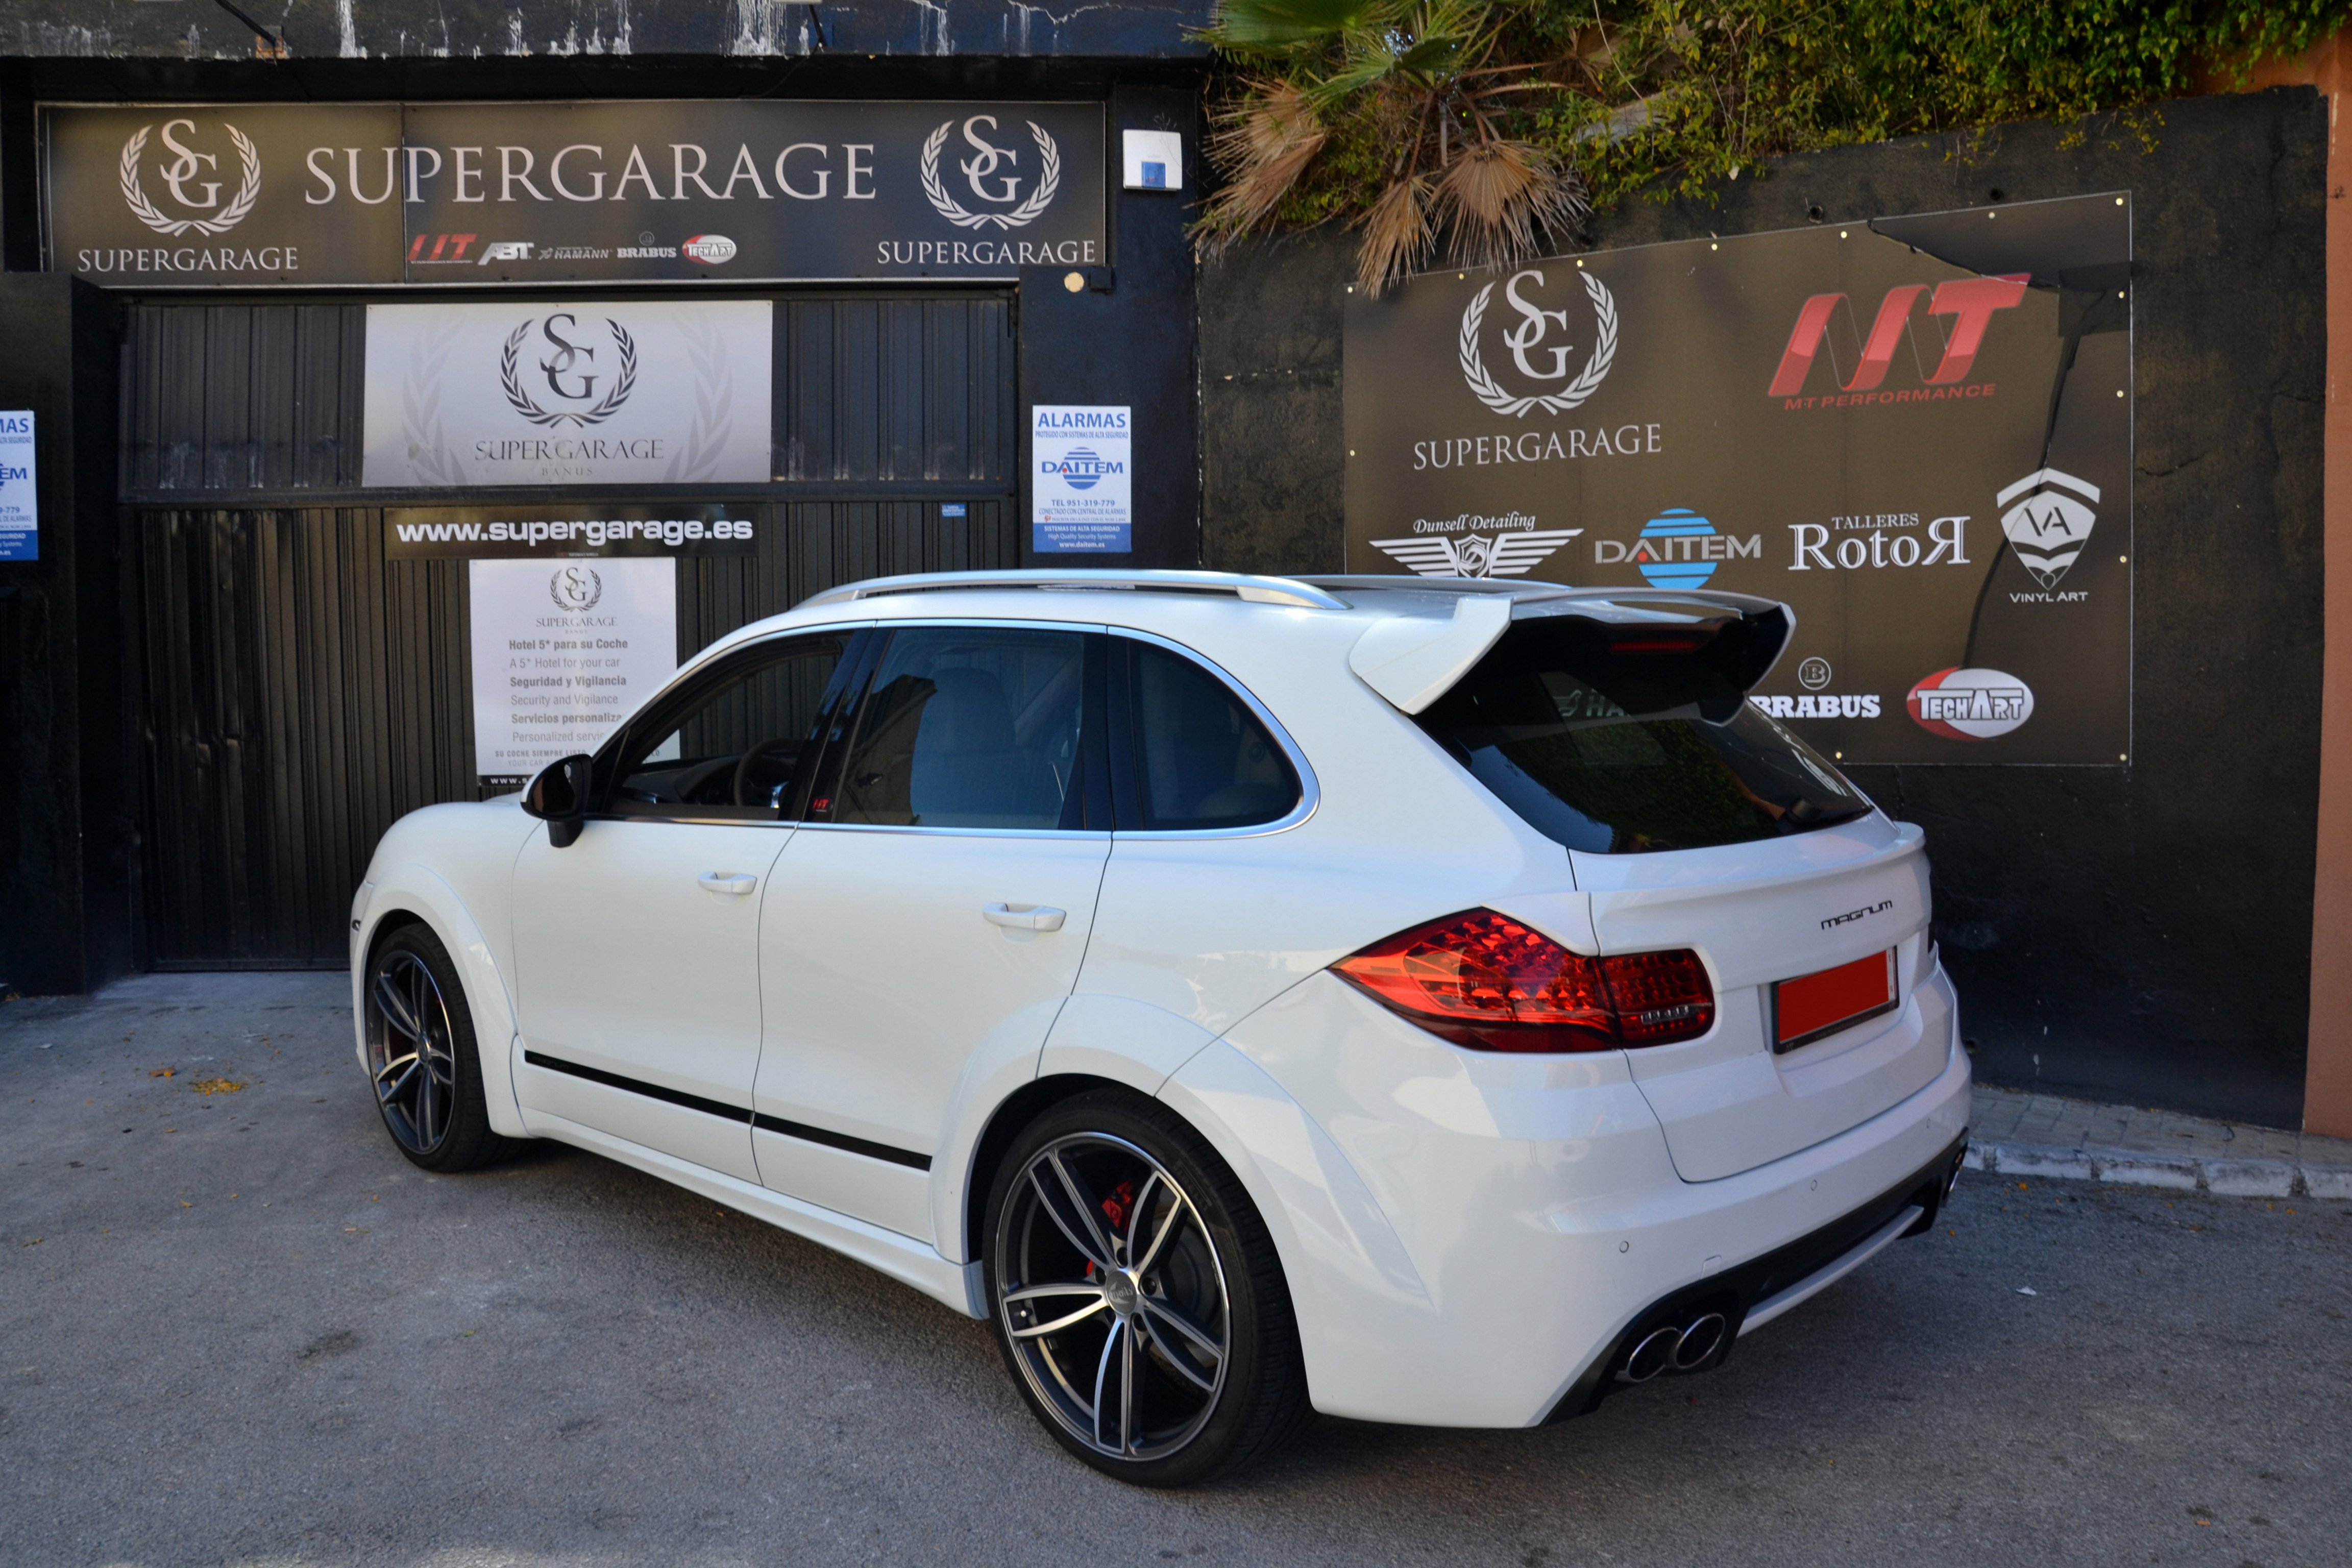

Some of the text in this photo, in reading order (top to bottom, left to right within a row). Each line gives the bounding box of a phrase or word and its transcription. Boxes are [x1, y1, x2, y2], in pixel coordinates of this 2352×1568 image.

[306, 142, 877, 204] SUPERGARAGE
[478, 242, 534, 265] ABT
[554, 249, 609, 259] HAMANN
[617, 247, 677, 258] BRABUS
[877, 240, 1096, 264] SUPERGARAGE
[78, 247, 299, 272] SUPERGARAGE
[1785, 384, 1996, 410] MT PERFORMANCE
[1038, 413, 1126, 428] ALARMAS
[475, 439, 664, 461] SUPERGARAGE
[1413, 424, 1662, 471] SUPERGARAGE
[542, 467, 594, 477] BANUS
[1042, 461, 1123, 473] DAITEM
[1413, 511, 1536, 533] Dunsell Detailing
[1831, 513, 1919, 530] TALLERES
[397, 520, 753, 546] www.supergarage.es
[1595, 534, 1761, 564] DAITEM
[2010, 592, 2088, 603] VINYL ART
[536, 617, 618, 628] SUPERGARAGE
[509, 639, 536, 650] Hotel
[554, 641, 577, 652] para
[580, 641, 593, 649] su
[596, 638, 628, 649] Coche
[510, 659, 517, 668] A
[535, 657, 560, 668] Hotel
[563, 657, 576, 668] for
[579, 660, 602, 671] your
[605, 659, 621, 667] car
[510, 675, 627, 689] Seguridad y Vigilancia
[511, 694, 618, 707] Security and Vigilance
[512, 713, 622, 725] Servicios personaliza
[513, 731, 605, 742] Personalized servic
